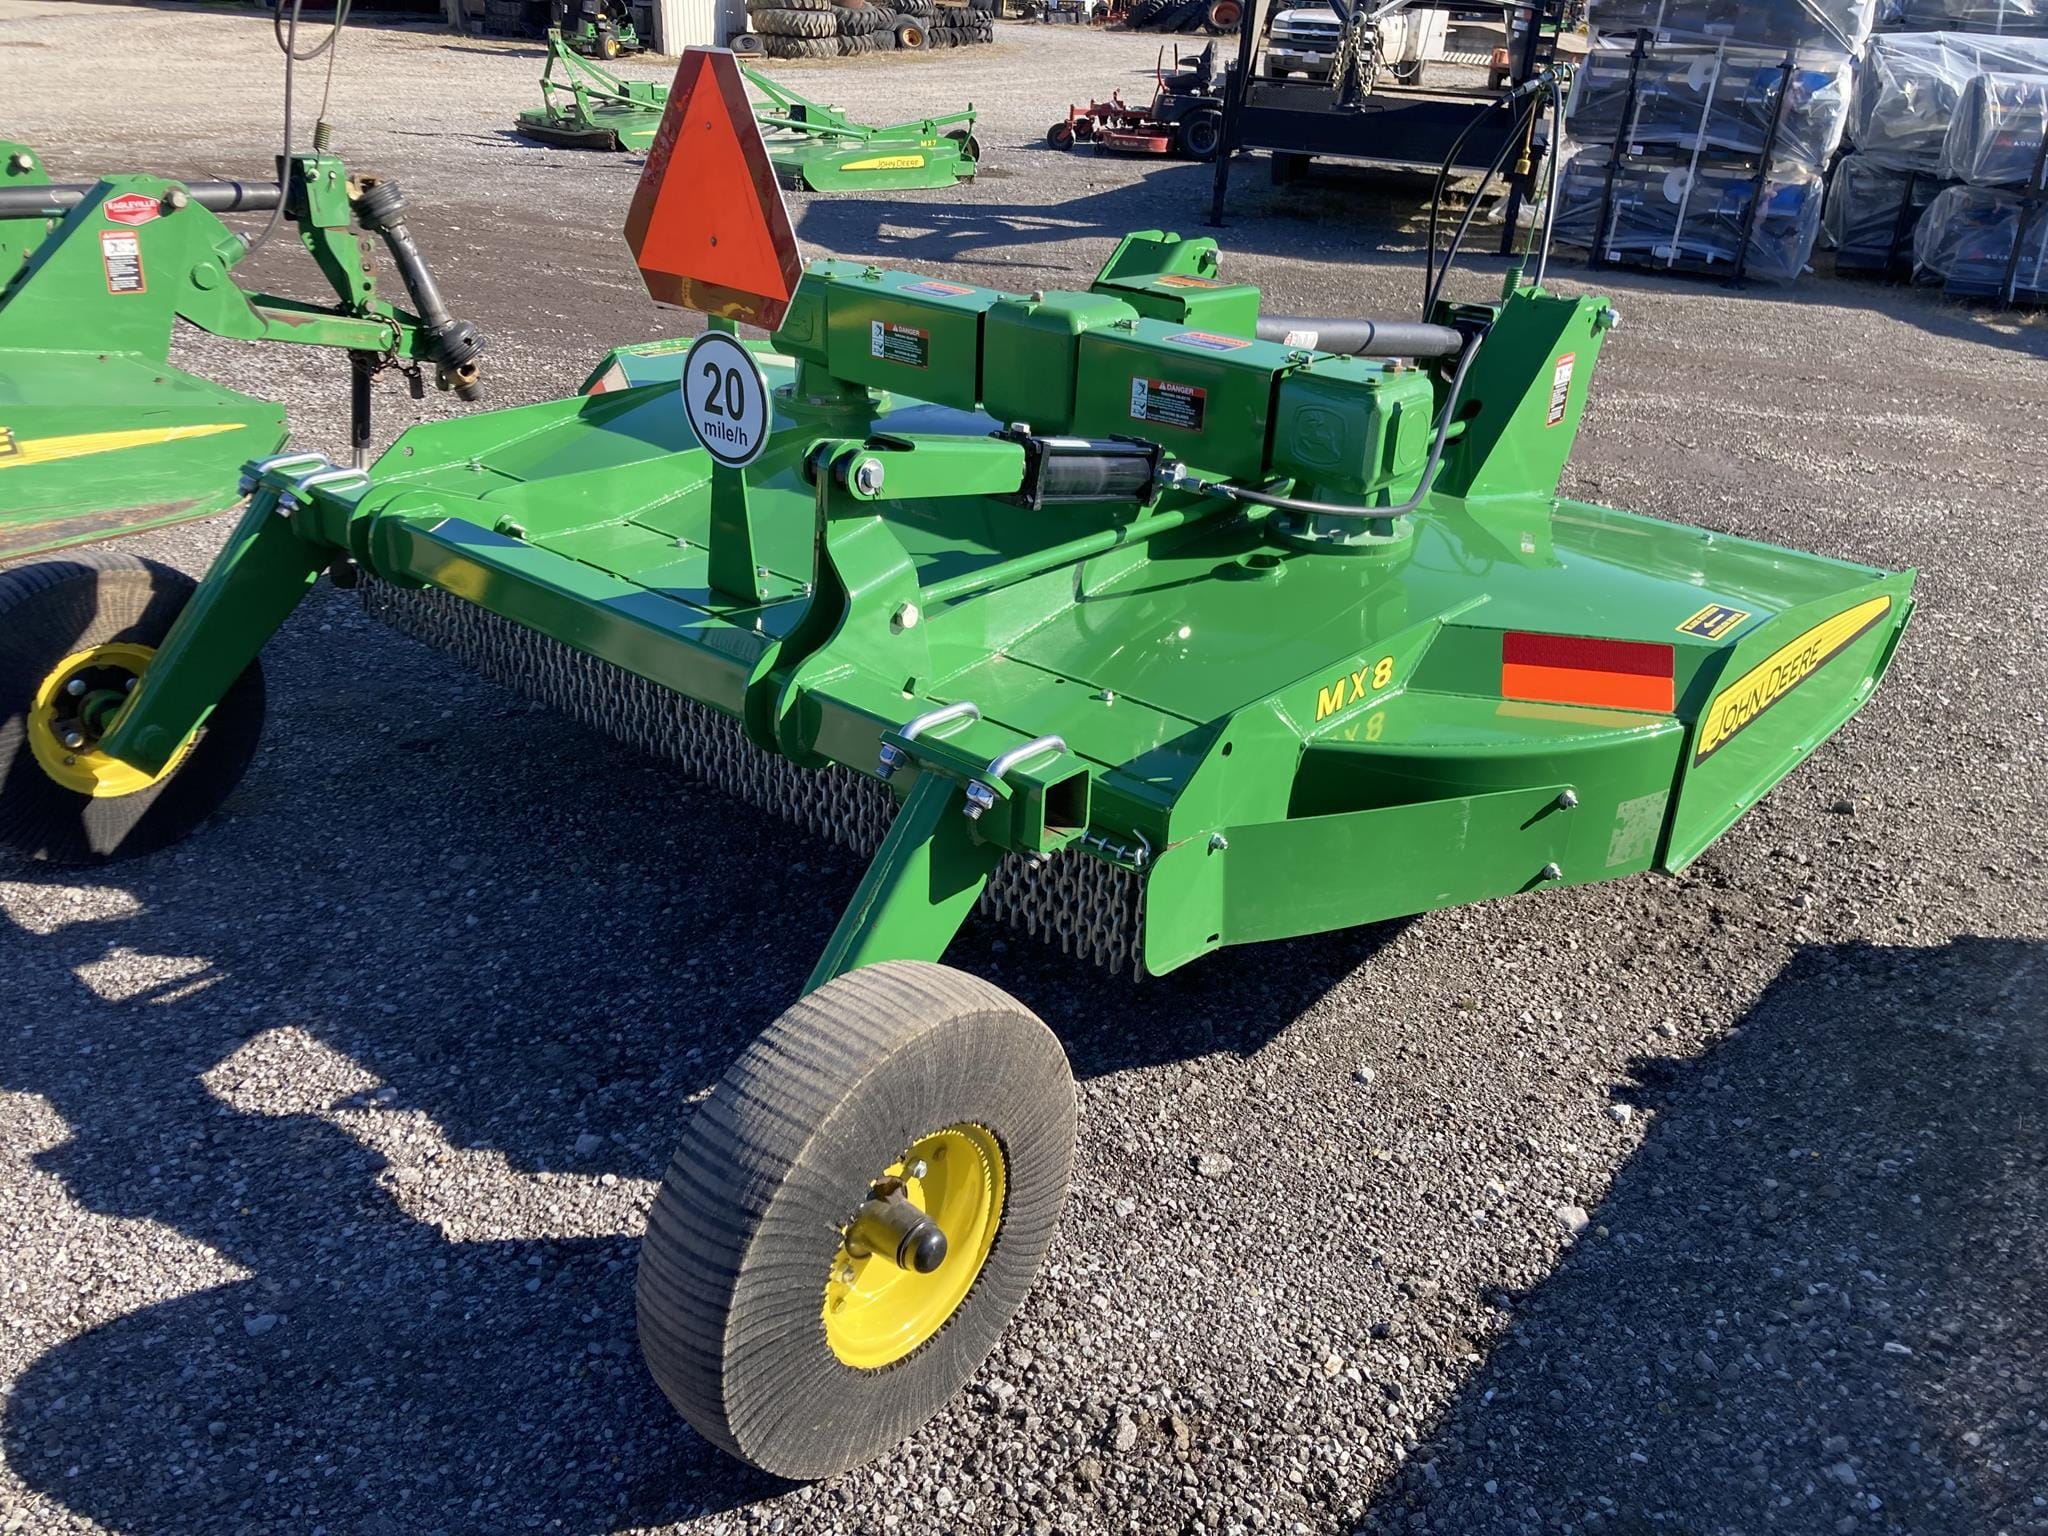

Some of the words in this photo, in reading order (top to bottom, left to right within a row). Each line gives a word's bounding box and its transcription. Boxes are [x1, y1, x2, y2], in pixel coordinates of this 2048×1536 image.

[920, 139, 937, 147] MX7
[877, 160, 896, 168] JOHN
[896, 159, 919, 167] DEERE
[898, 326, 920, 337] DANGER
[703, 362, 745, 421] 20
[1166, 383, 1194, 396] DANGER
[704, 421, 748, 447] mile/h
[1315, 655, 1394, 722] MX8
[1711, 682, 1766, 745] JOHN
[1765, 638, 1823, 702] DEERE
